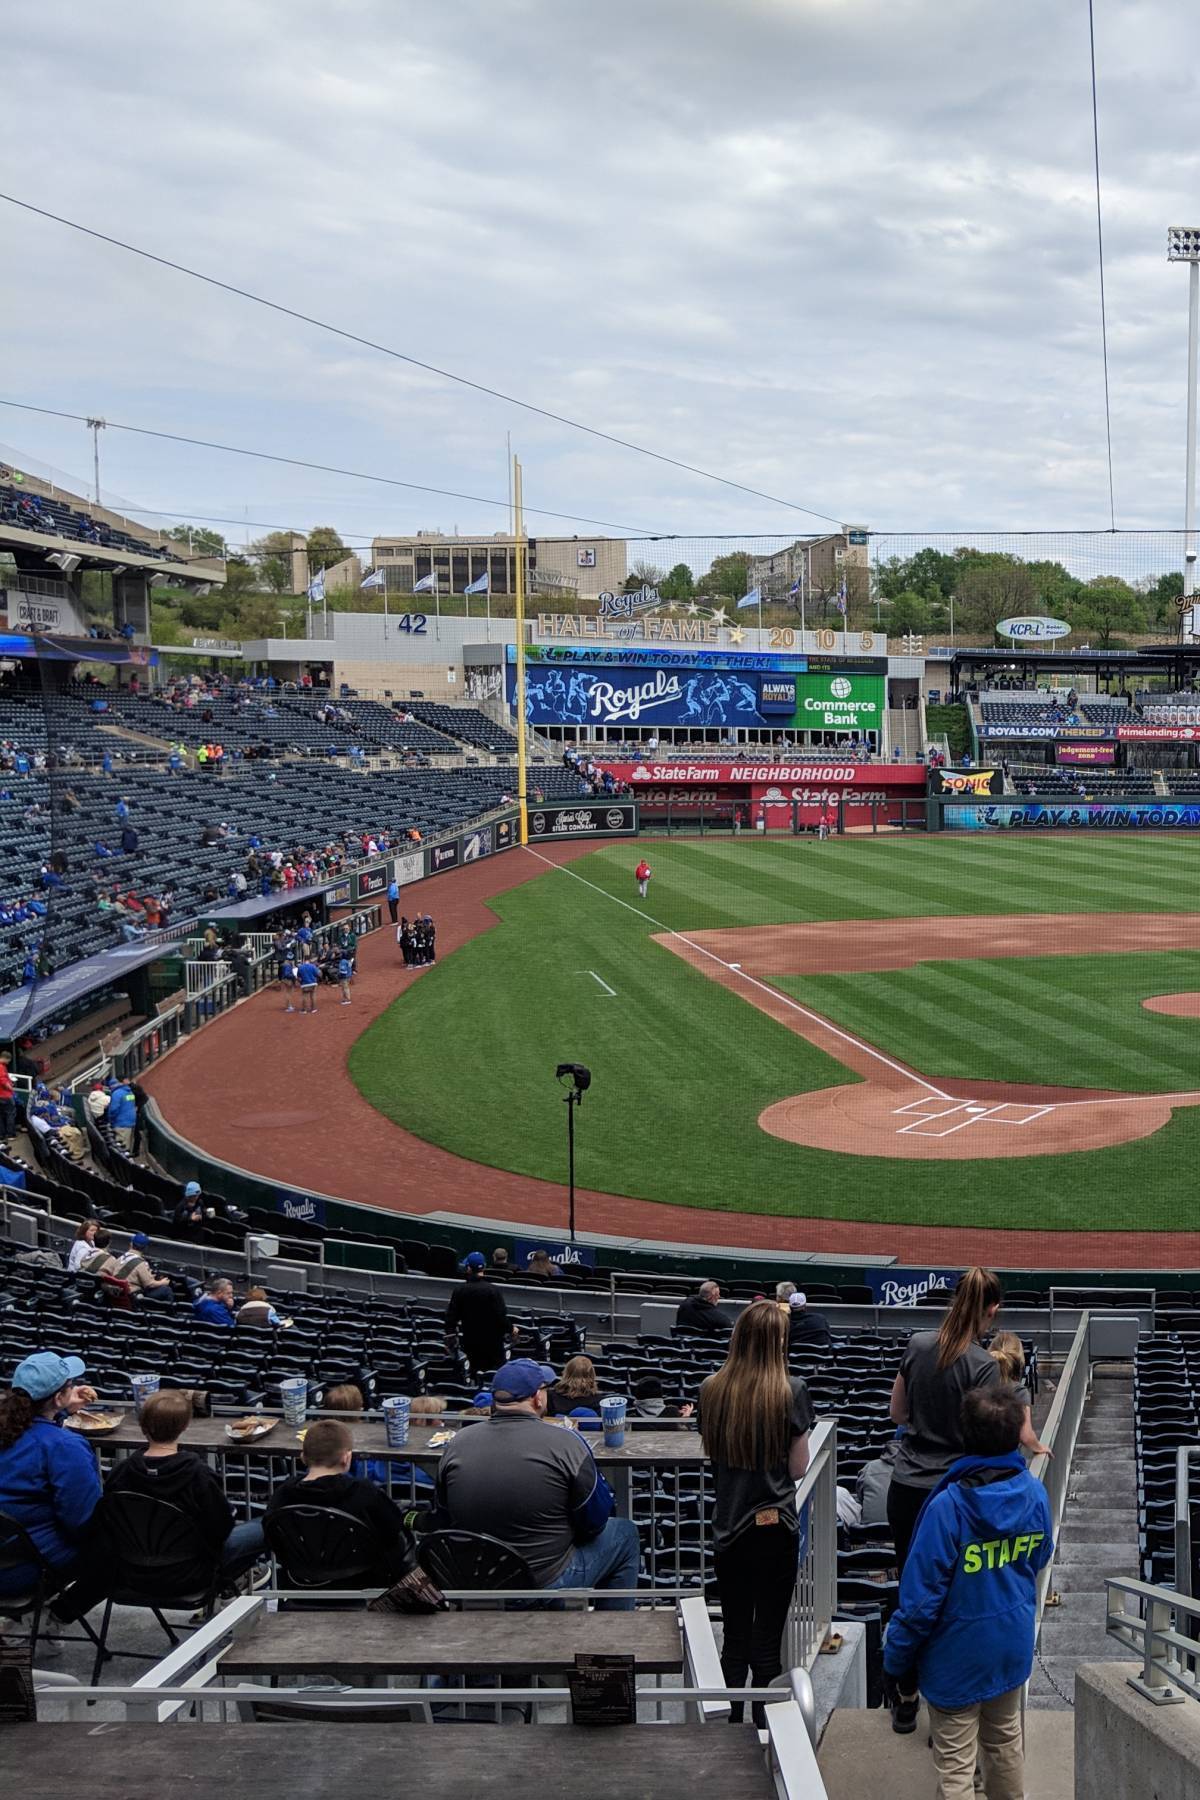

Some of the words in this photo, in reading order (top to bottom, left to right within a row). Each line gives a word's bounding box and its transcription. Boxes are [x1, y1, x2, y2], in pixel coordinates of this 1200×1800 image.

[598, 584, 662, 619] Royals
[398, 613, 427, 634] 42
[537, 613, 614, 639] HALL
[618, 623, 640, 642] of
[643, 617, 720, 643] FAME
[1009, 624, 1042, 636] KCP&L
[769, 627, 795, 648] 20
[815, 628, 836, 650] 10
[859, 631, 874, 650] 5
[562, 650, 601, 663] PLAY
[604, 651, 616, 663] &
[618, 652, 649, 663] WIN
[652, 653, 702, 665] TODAY
[703, 655, 725, 666] AT
[725, 656, 753, 667] THE
[753, 657, 771, 668] K!
[587, 669, 683, 722] Royals
[762, 683, 796, 693] ALWAYS
[762, 692, 789, 701] ROYAL
[804, 697, 876, 712] Commerce
[824, 712, 858, 725] Bank
[988, 726, 1106, 738] ROYALS.COM/THEKEEP
[1118, 727, 1179, 738] PrimeLending
[652, 766, 686, 780] State
[687, 767, 719, 780] Farm
[730, 767, 856, 781] NEIGHBORHOOD
[944, 777, 990, 789] SONIC
[791, 787, 839, 808] State
[841, 787, 887, 808] Farm
[1008, 810, 1064, 827] PLAY
[1067, 810, 1082, 827] &
[1087, 810, 1132, 827] WIN
[283, 1198, 317, 1221] Royals
[880, 1272, 948, 1307] Royals
[963, 1533, 1044, 1574] STAFF
